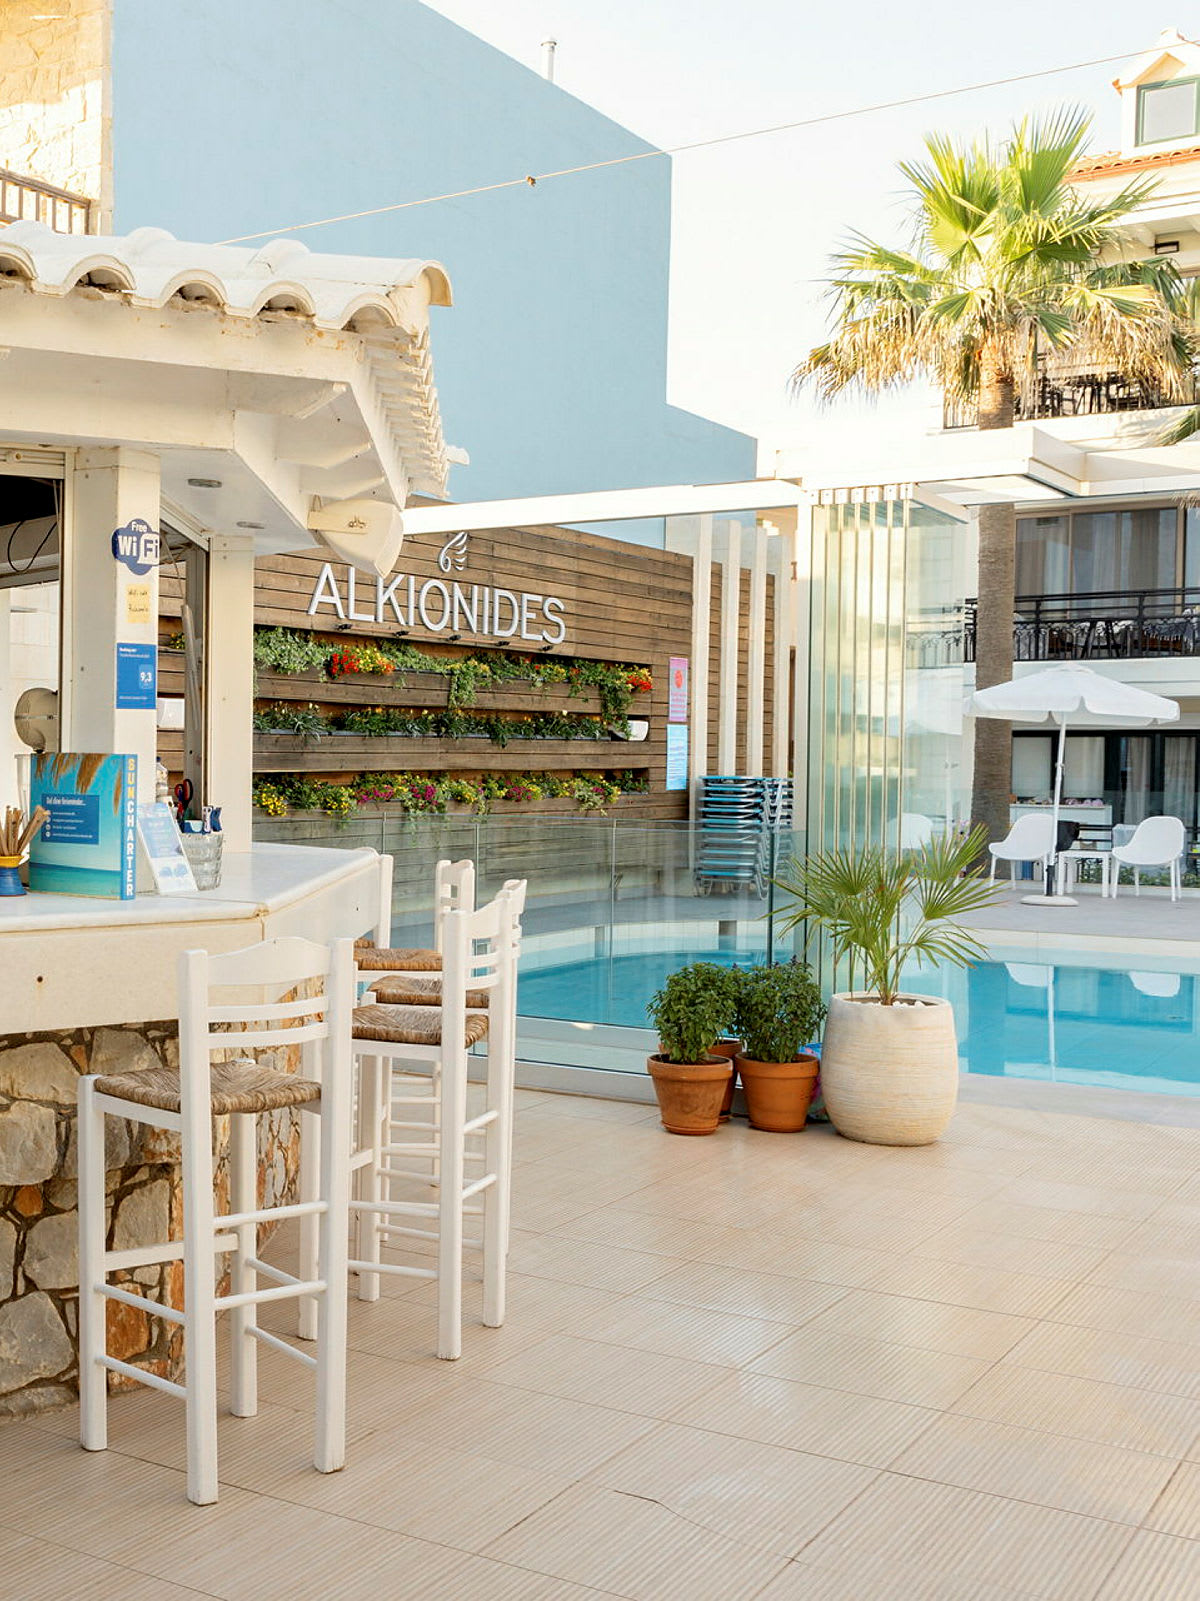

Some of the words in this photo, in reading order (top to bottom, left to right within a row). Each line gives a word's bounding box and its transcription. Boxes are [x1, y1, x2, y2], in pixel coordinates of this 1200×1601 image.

[131, 521, 148, 533] Free
[118, 535, 158, 559] WiFi
[307, 562, 567, 645] ALKIONIDES
